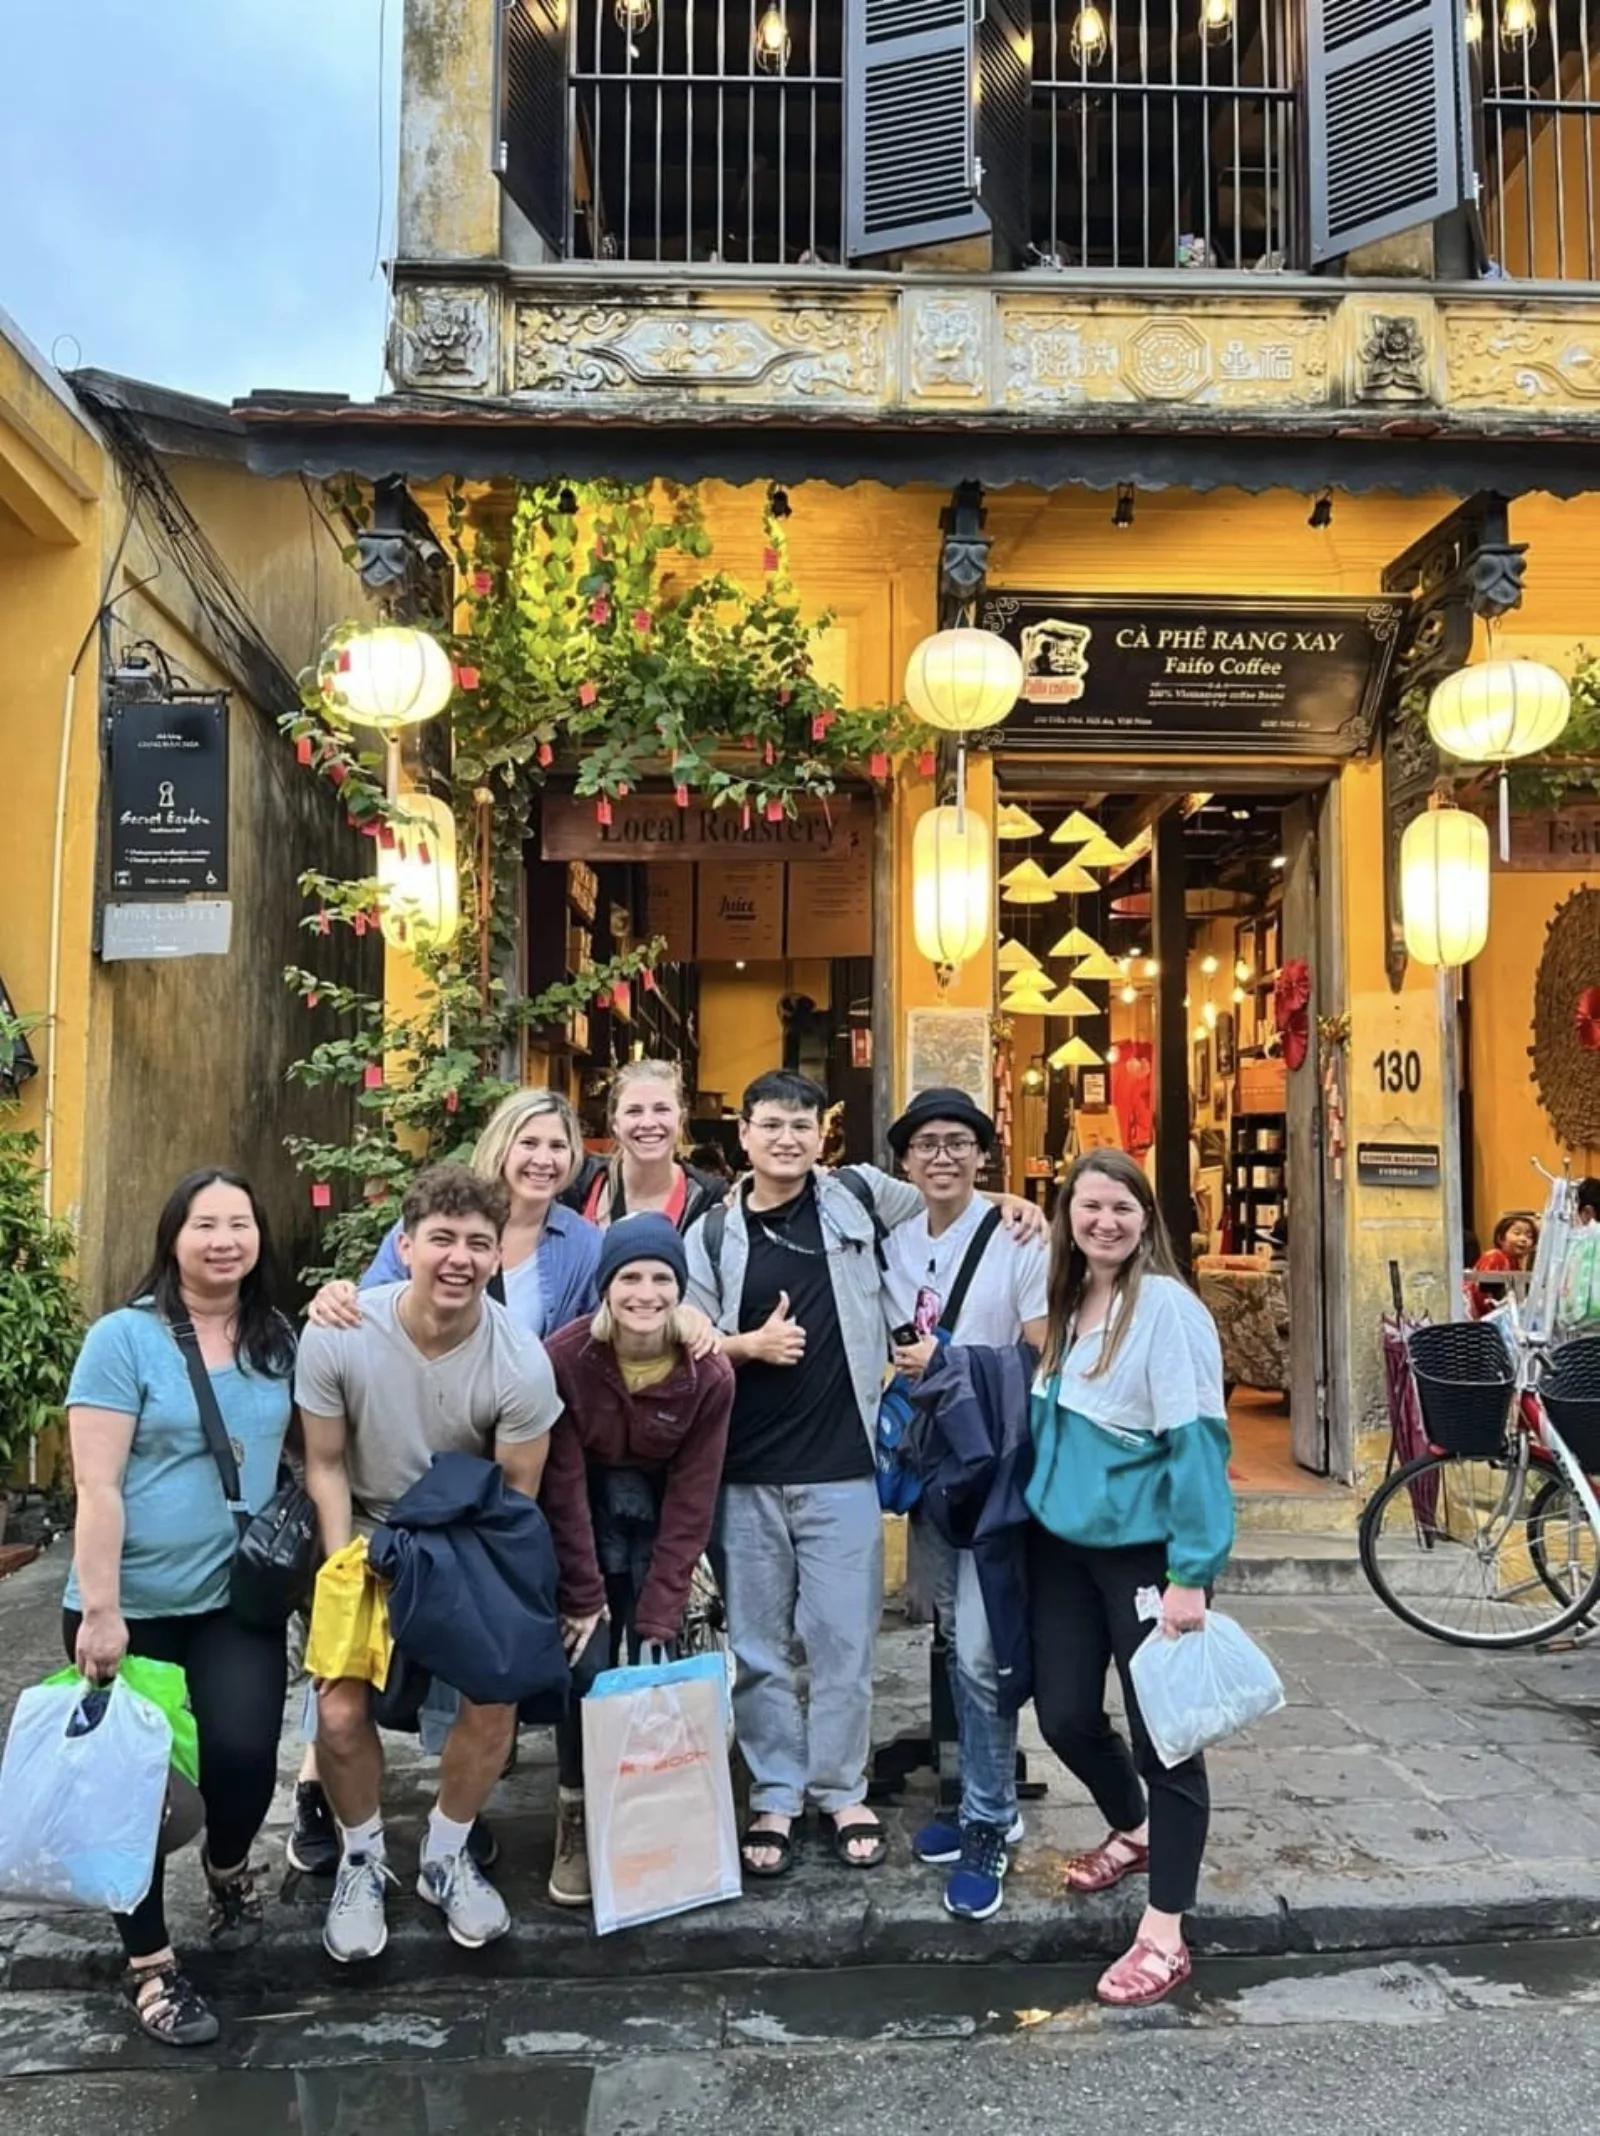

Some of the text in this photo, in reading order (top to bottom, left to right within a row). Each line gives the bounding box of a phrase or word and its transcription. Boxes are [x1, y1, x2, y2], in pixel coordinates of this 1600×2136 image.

[1115, 623, 1344, 651] CÀ PHÊ RANG XAY
[1164, 656, 1282, 676] Faifo Coffee
[119, 808, 211, 825] Secret Garden
[601, 807, 839, 852] Local Roastery
[1373, 1050, 1421, 1093] 130
